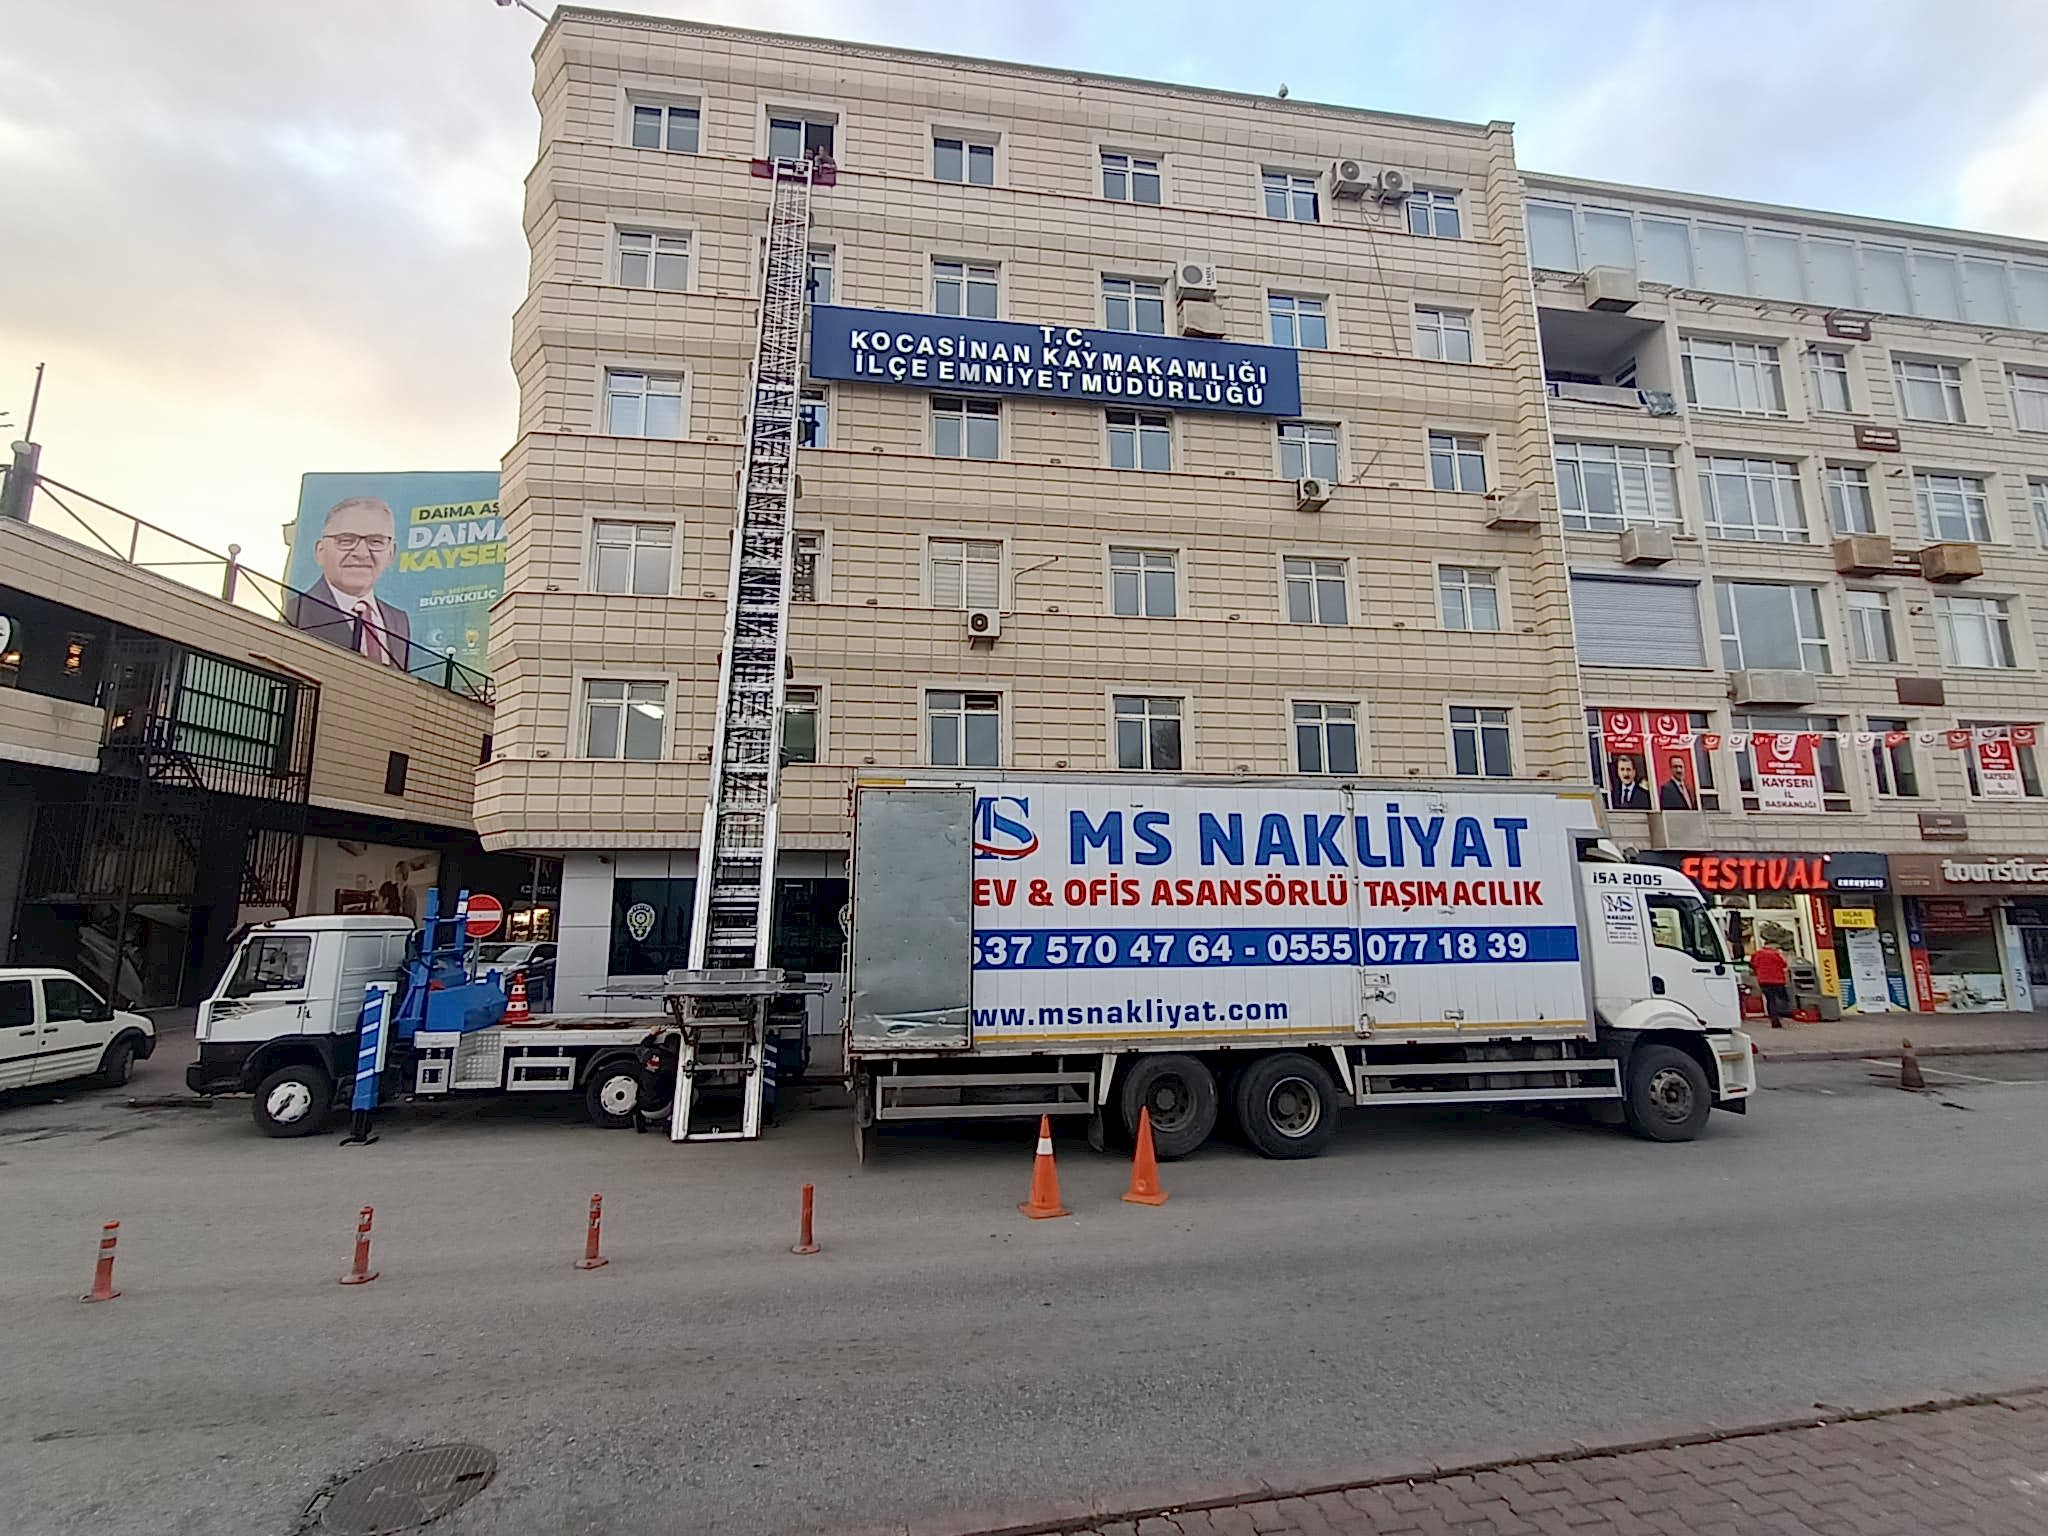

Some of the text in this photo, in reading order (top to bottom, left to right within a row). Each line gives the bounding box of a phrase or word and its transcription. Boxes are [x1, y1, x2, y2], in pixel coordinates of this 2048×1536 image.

[1039, 326, 1092, 348] T.C.
[851, 330, 1268, 385] KOCASİNAN KAYMAKAMLIĞI
[855, 350, 1264, 407] İLÇE EMNİYET MÜDÜRLÜĞÜ
[418, 505, 475, 520] DAİMA
[1069, 802, 1529, 868] MS NAKLİYAT
[973, 873, 1544, 913] EV & OFİS ASANSÖRLÜ TAŞIMACILIK
[1623, 873, 1662, 886] 2005
[1046, 935, 1118, 965] 570
[1129, 935, 1175, 963] 47
[1187, 934, 1233, 963] 64
[1266, 933, 1354, 962] 0555
[1366, 933, 1434, 961] 077
[1438, 933, 1477, 960] 18
[1488, 932, 1528, 959] 39
